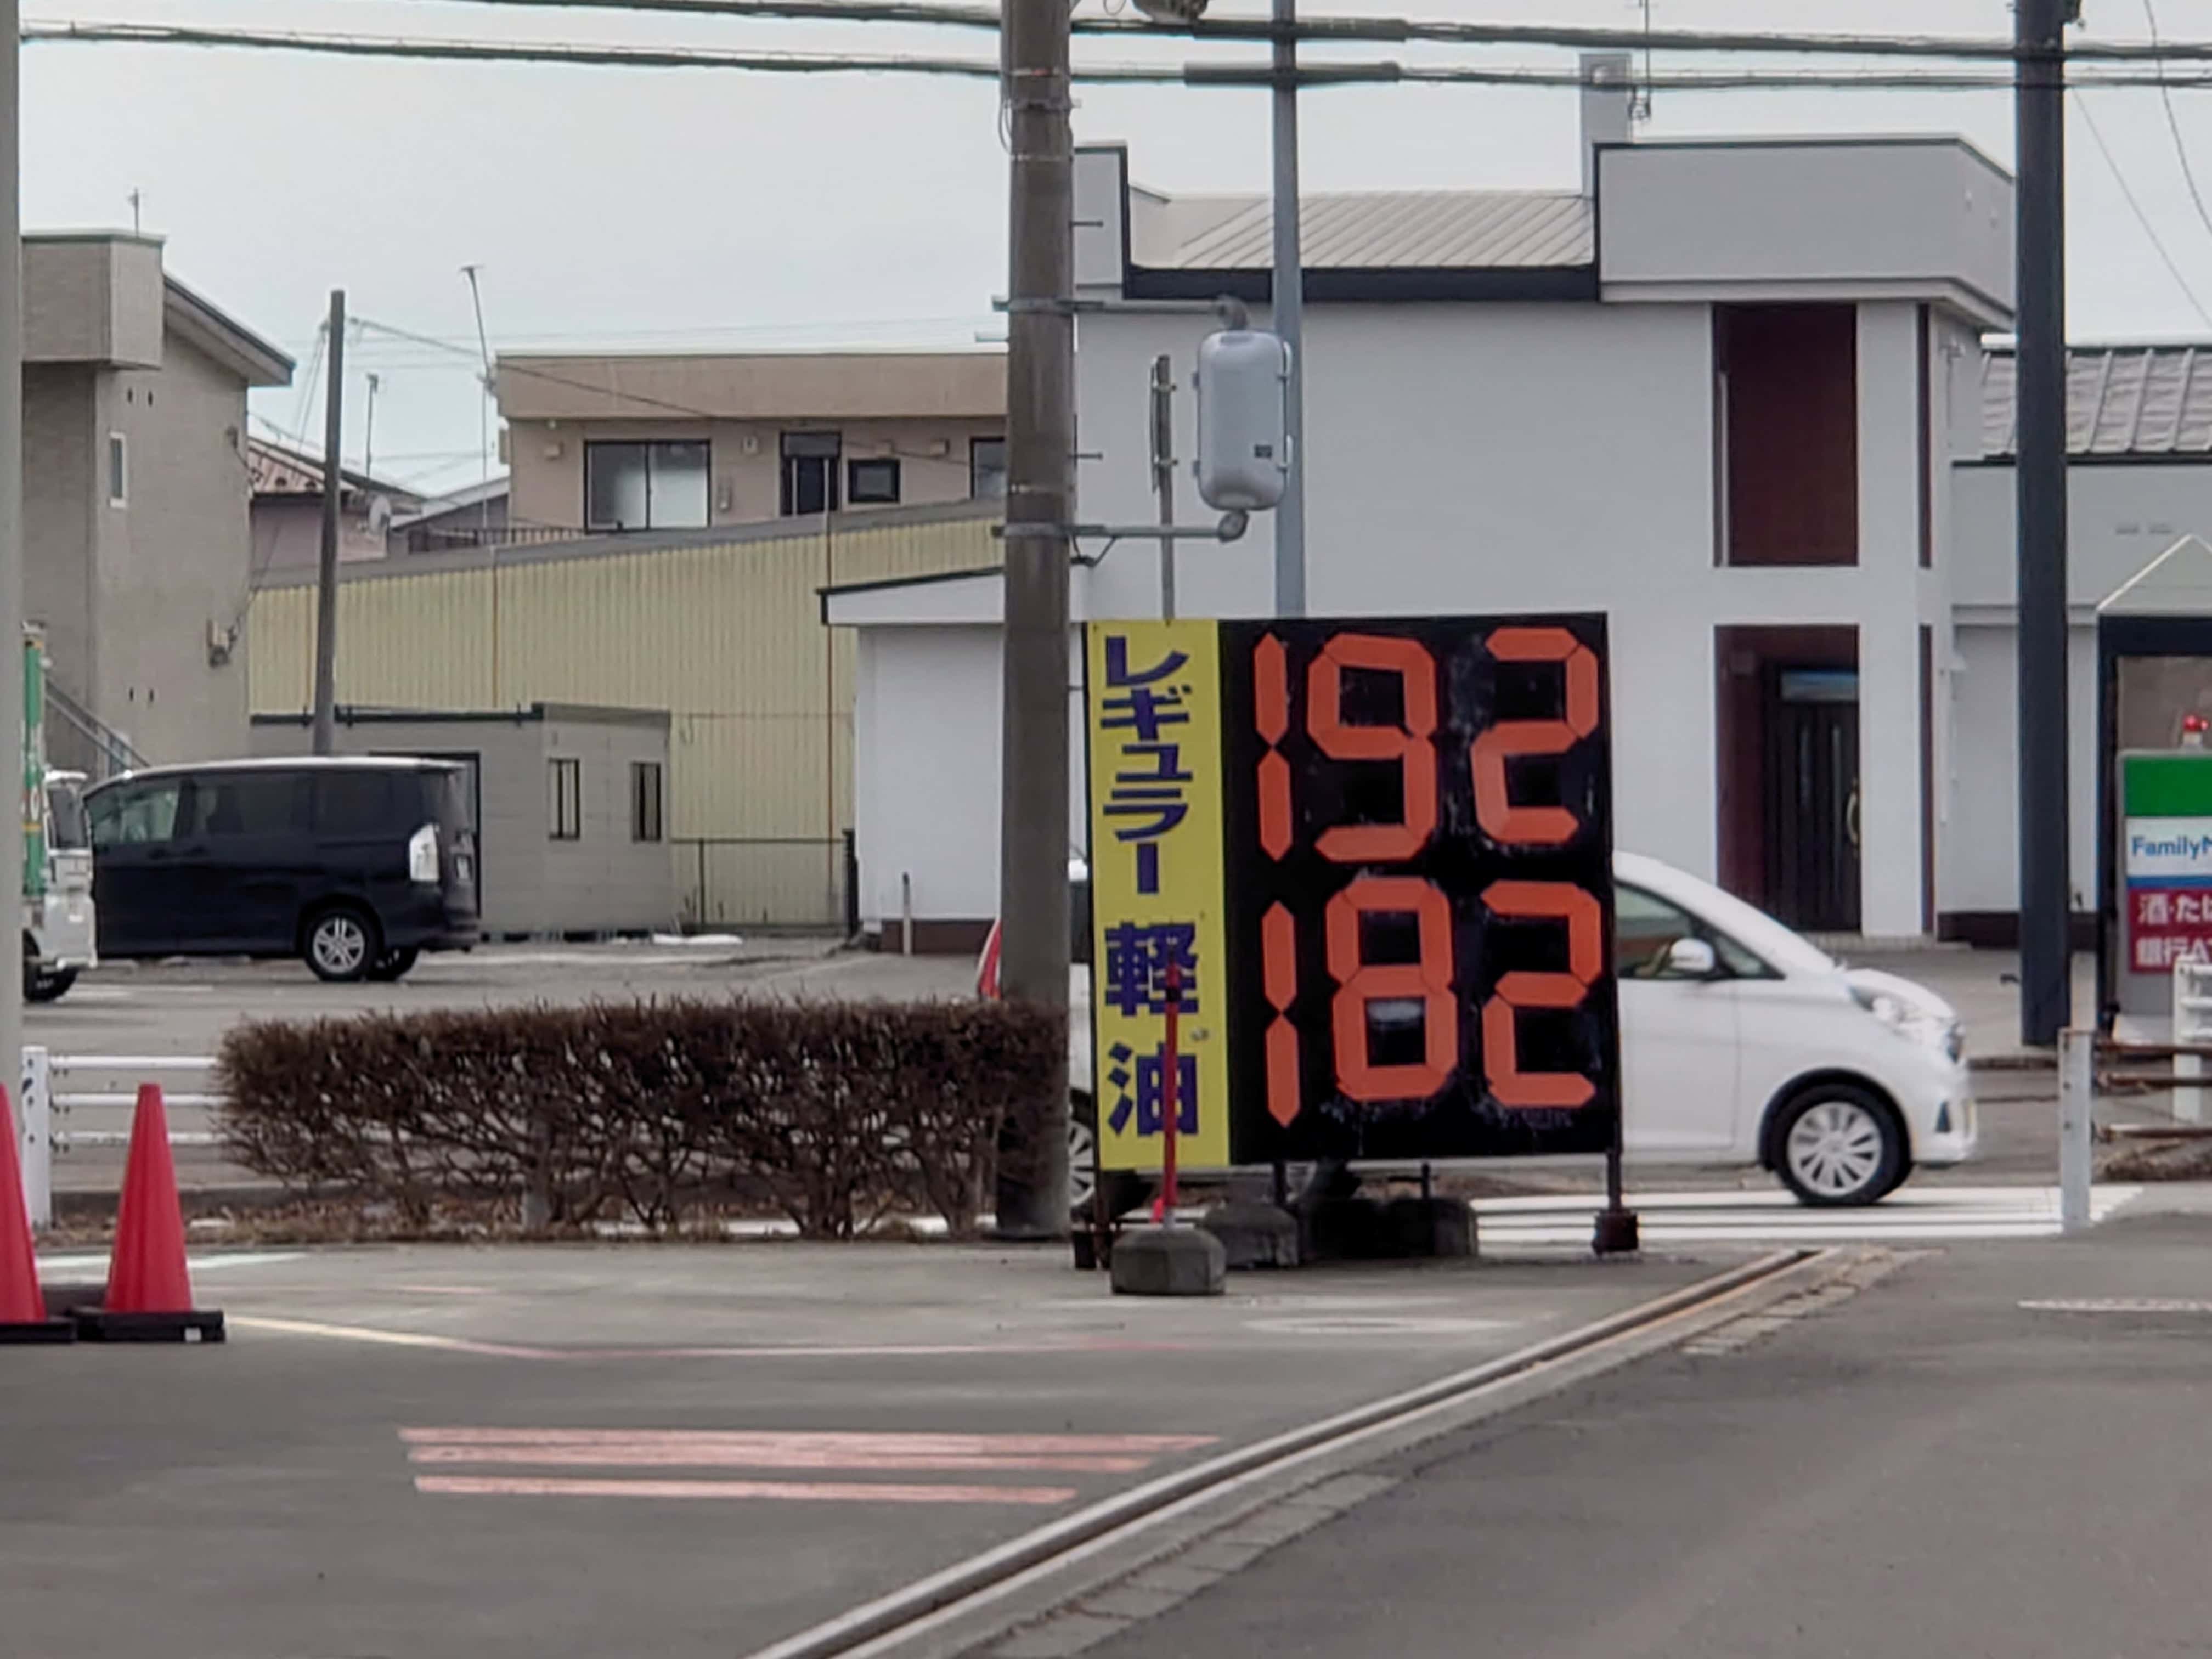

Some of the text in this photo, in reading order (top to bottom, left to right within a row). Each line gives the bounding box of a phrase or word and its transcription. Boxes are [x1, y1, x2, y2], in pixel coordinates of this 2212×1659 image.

[1099, 634, 1193, 895] レギュラー
[1254, 627, 1600, 864] 192
[1104, 921, 1199, 1137] 軽油
[1261, 876, 1604, 1128] 182
